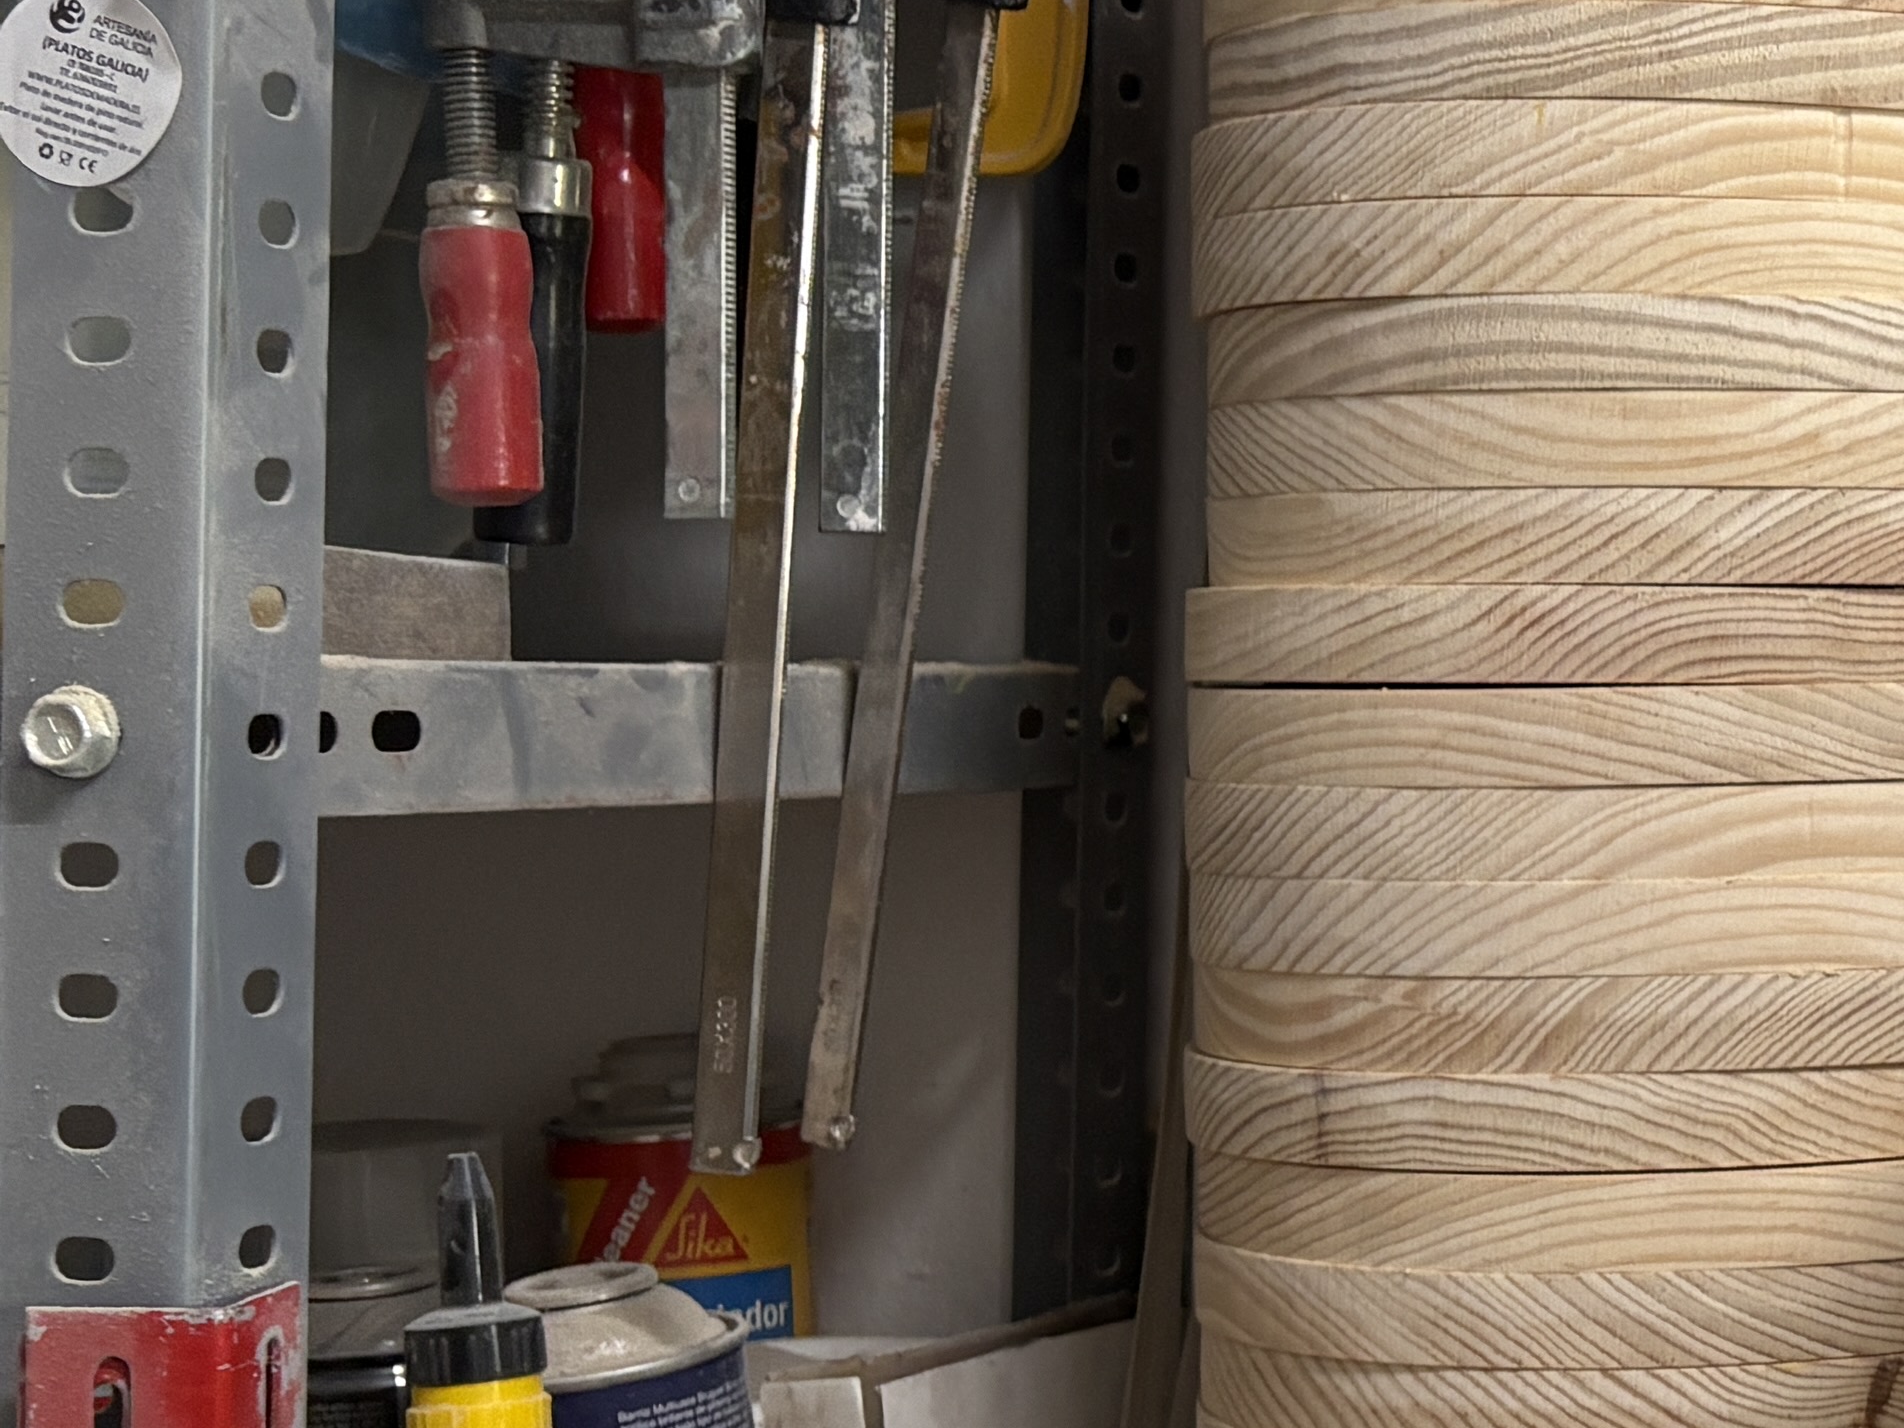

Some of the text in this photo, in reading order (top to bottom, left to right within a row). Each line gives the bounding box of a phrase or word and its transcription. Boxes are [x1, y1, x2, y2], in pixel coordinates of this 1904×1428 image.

[42, 36, 93, 62] (PLATOS
[96, 54, 149, 83] GALICIA)
[90, 27, 153, 58] DE GALICIA
[667, 1212, 735, 1260] Sika
